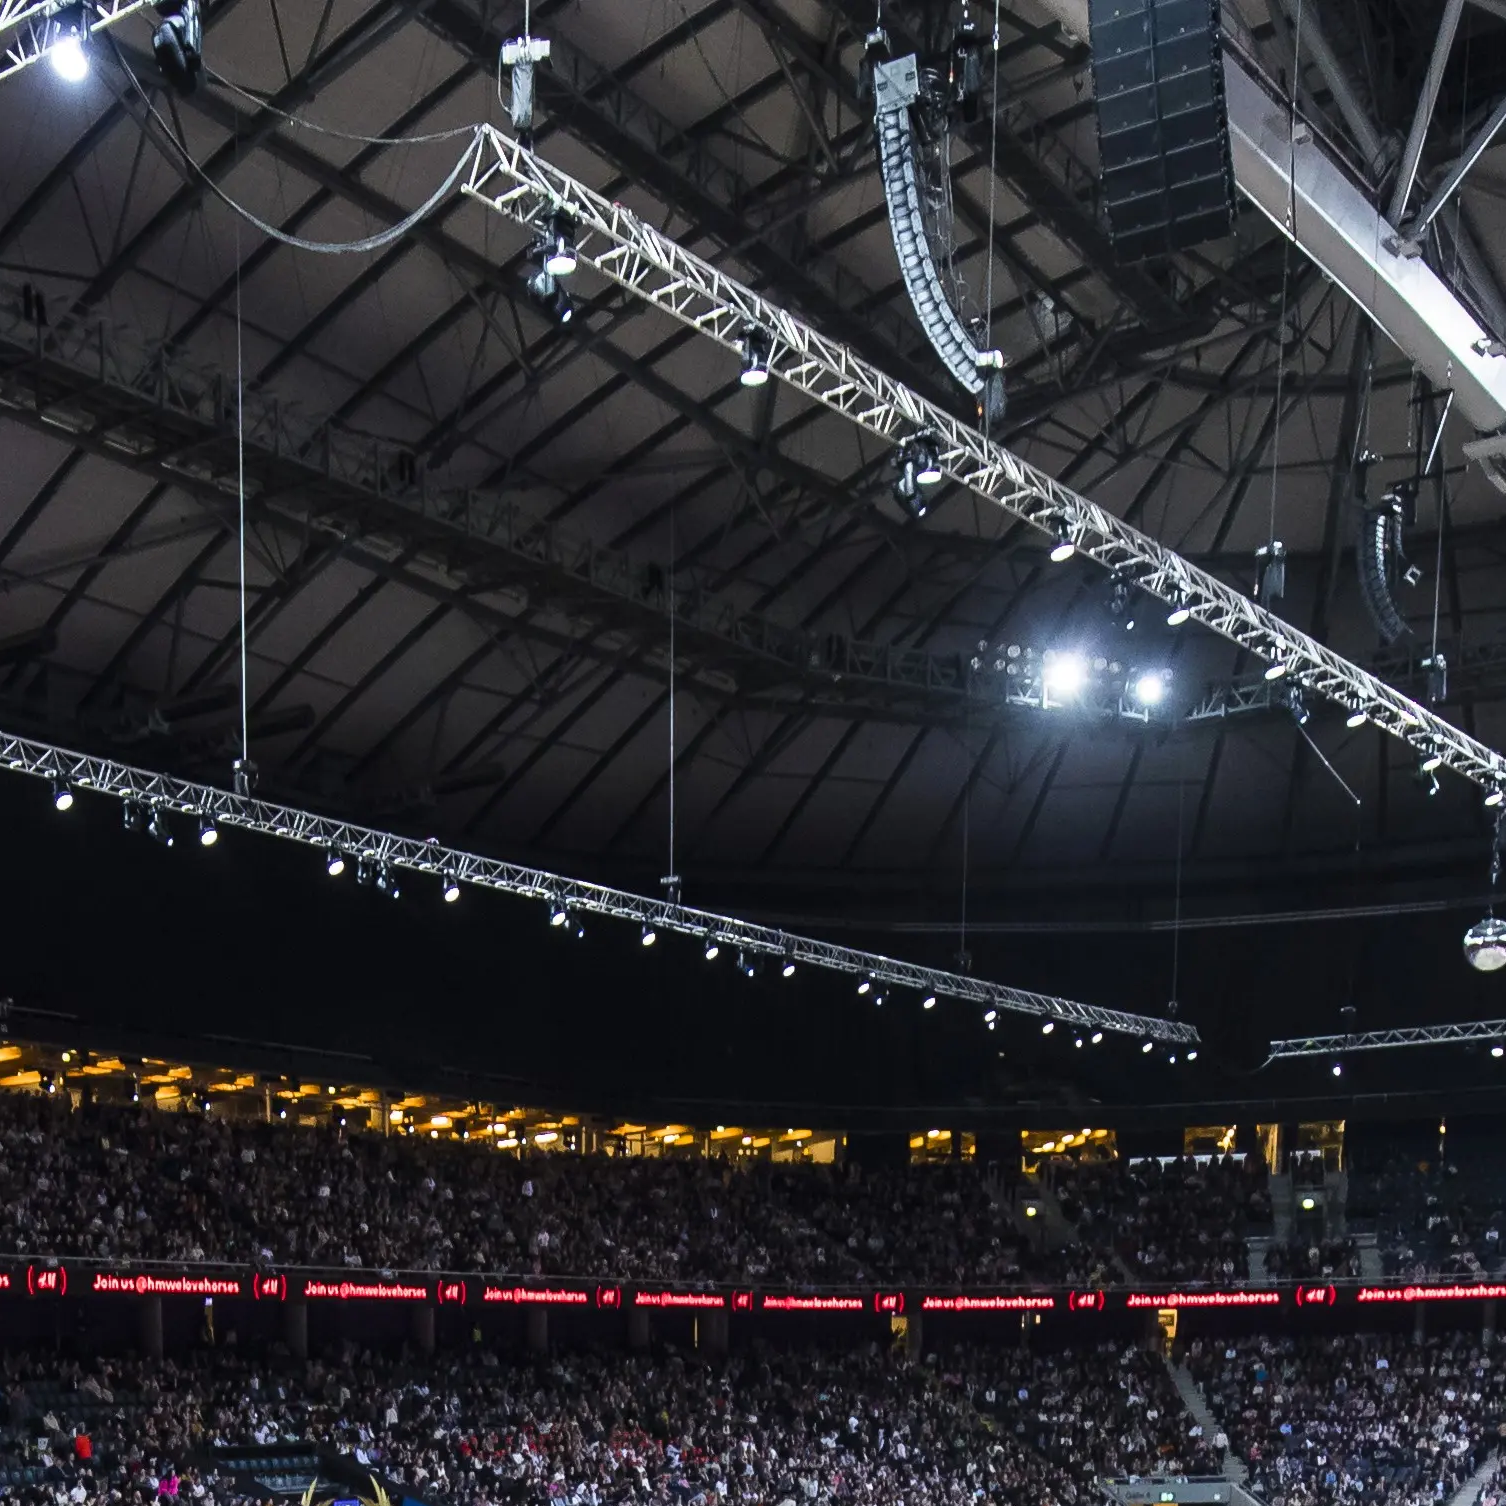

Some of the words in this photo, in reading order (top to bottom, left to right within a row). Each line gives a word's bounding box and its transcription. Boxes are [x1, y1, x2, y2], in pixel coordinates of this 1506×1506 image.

[93, 1274, 121, 1291] Join
[304, 1280, 329, 1297] Join
[1357, 1287, 1386, 1302] Join
